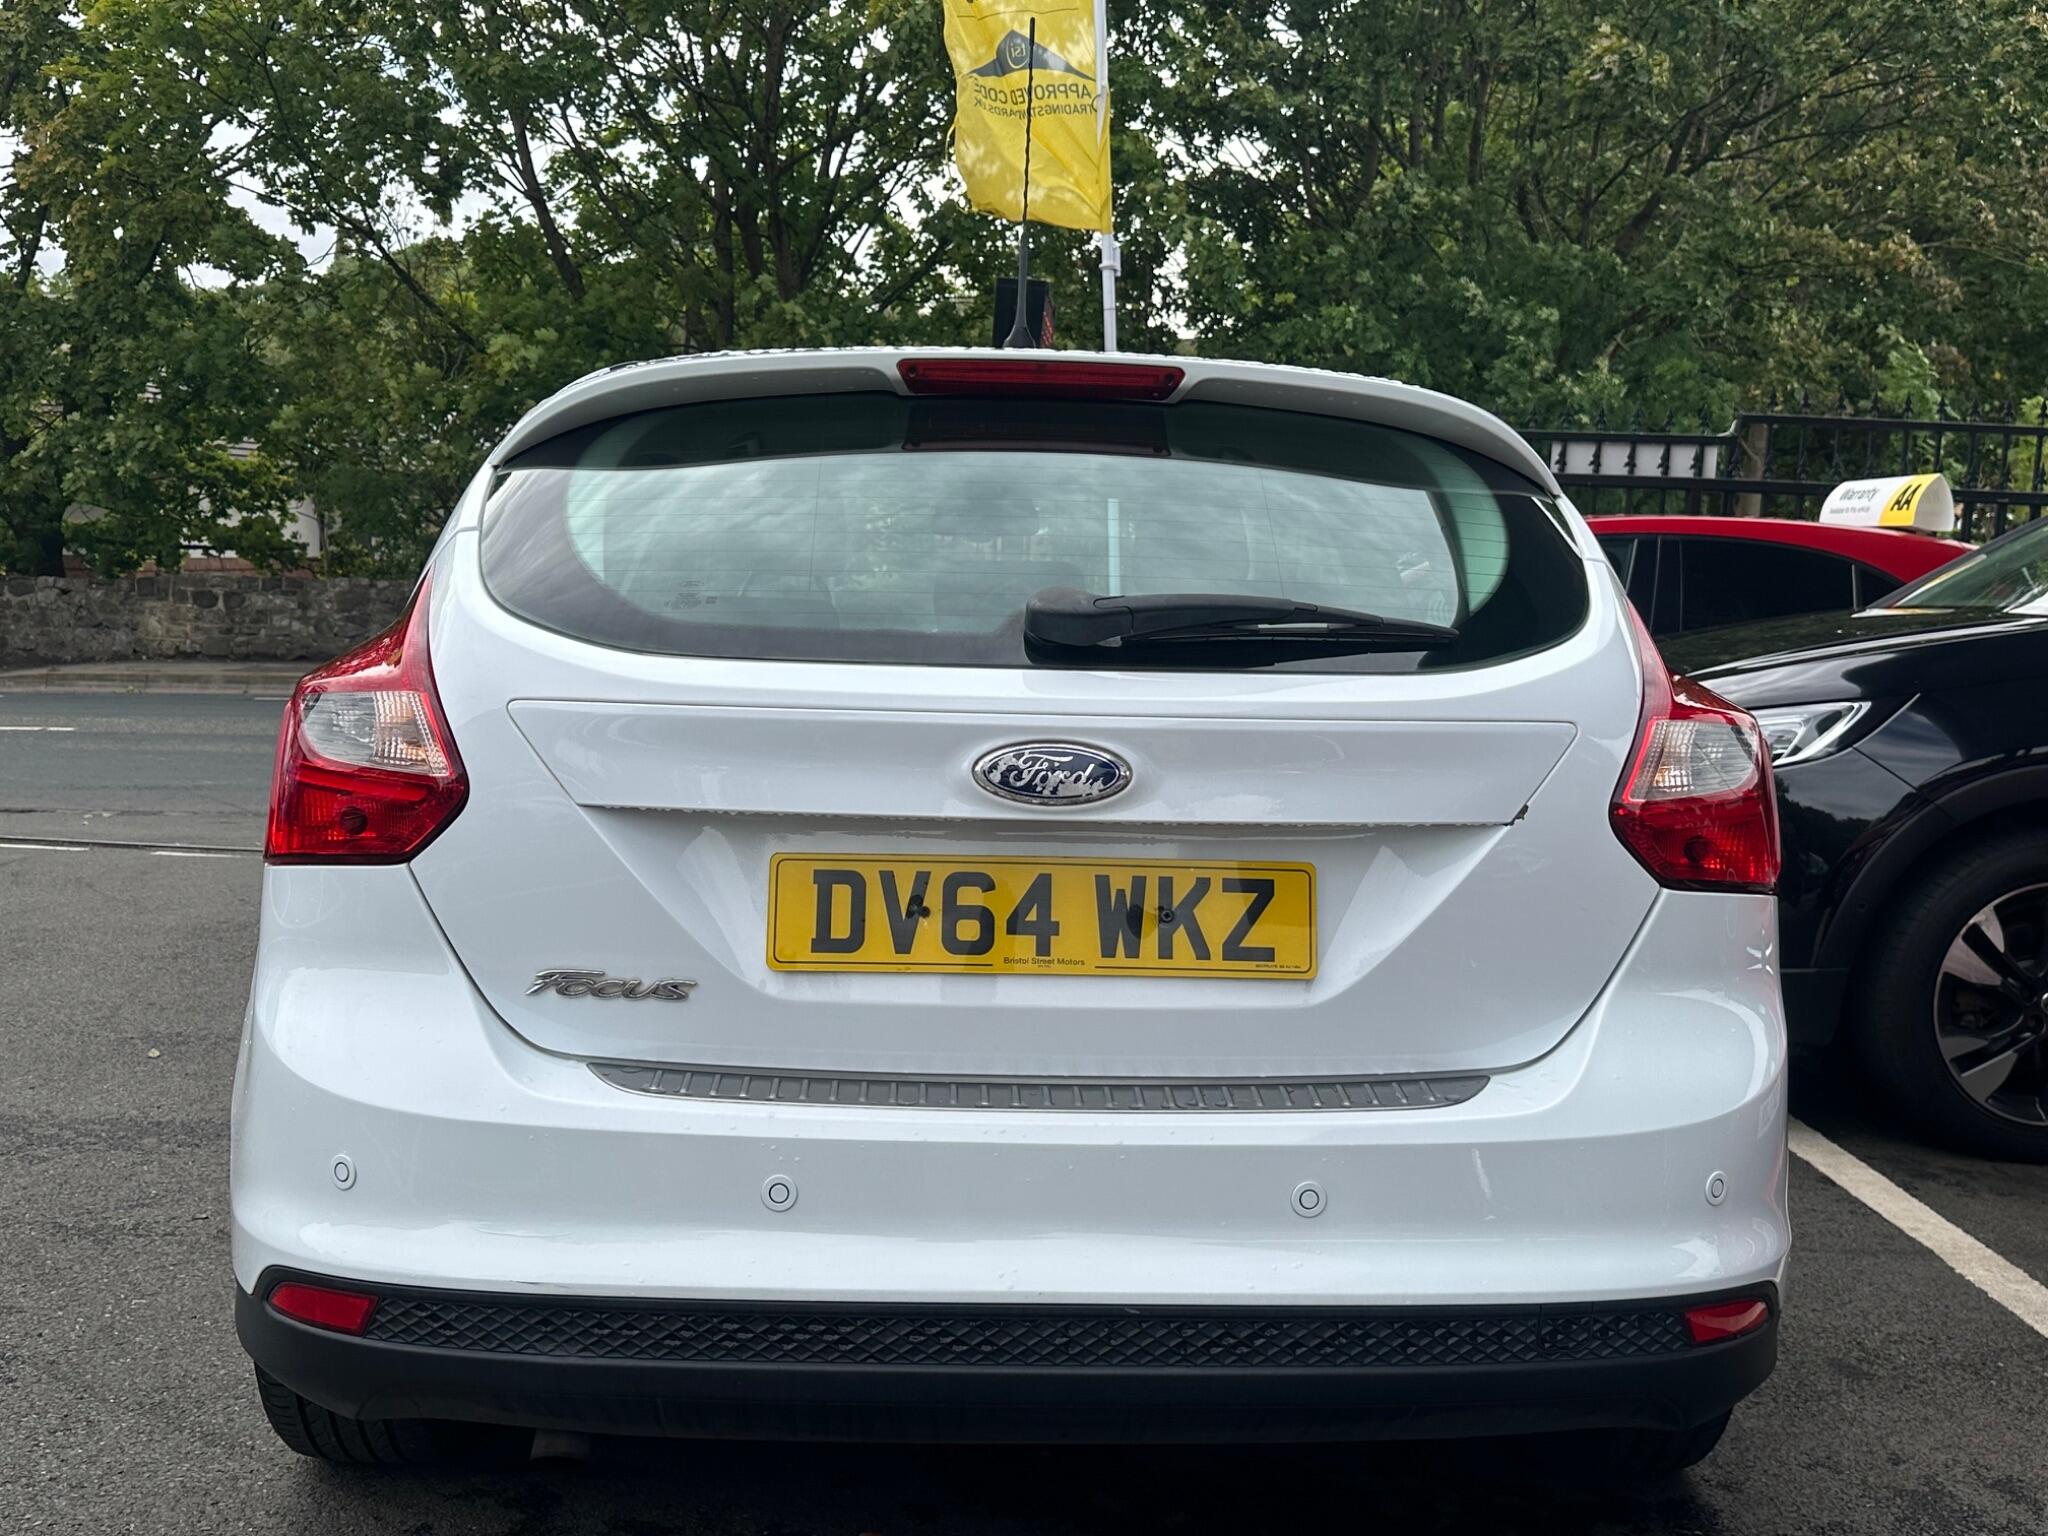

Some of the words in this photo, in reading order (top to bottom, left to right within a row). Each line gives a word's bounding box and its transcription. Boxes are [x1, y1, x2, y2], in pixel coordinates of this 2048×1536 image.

[1840, 487, 1880, 502] Warranty
[1890, 484, 1922, 511] AA
[1008, 751, 1097, 788] Ford
[811, 868, 1060, 957] DV64
[1095, 873, 1276, 963] WKZ
[1003, 956, 1029, 965] Bristol
[1031, 957, 1055, 965] Street
[1057, 958, 1086, 966] Motors
